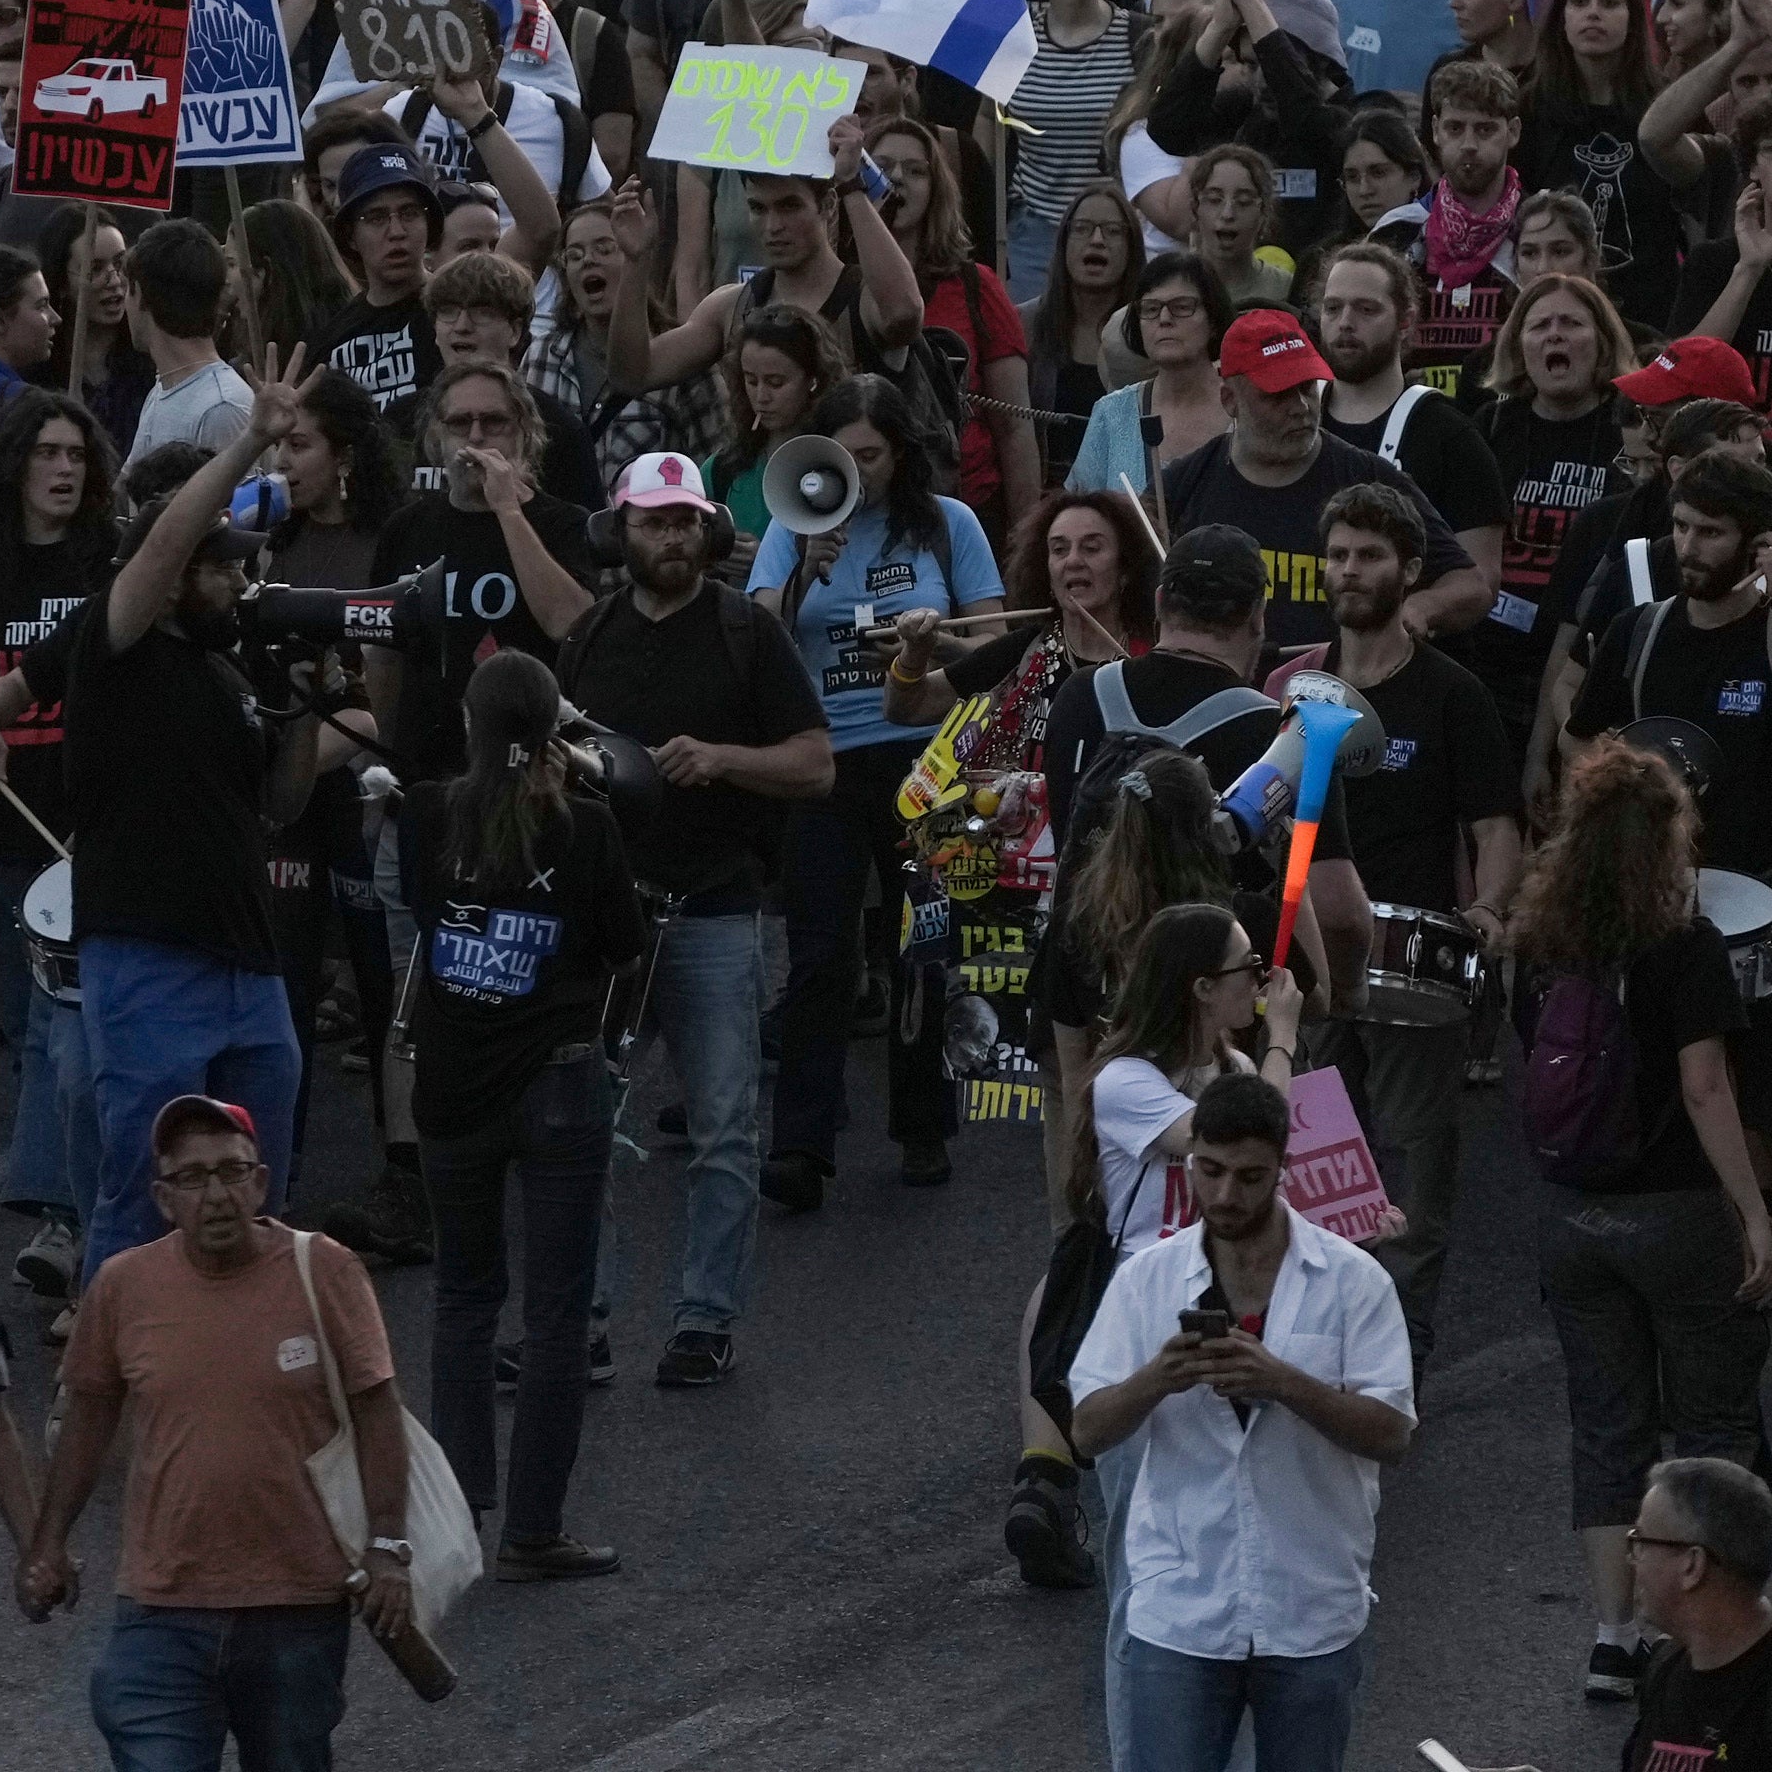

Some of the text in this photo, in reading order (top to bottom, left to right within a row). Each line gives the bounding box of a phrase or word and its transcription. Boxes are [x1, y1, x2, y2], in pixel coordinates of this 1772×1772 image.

[360, 7, 472, 79] 8.10
[782, 64, 850, 109] לא
[696, 101, 812, 170] 130
[27, 131, 171, 193] עכשיו!
[343, 605, 394, 627] FCK
[494, 912, 558, 947] היום
[959, 924, 1026, 958] בגין
[438, 931, 536, 979] שאחרי
[959, 964, 1032, 996] פטר
[969, 1079, 1046, 1122] ירות!
